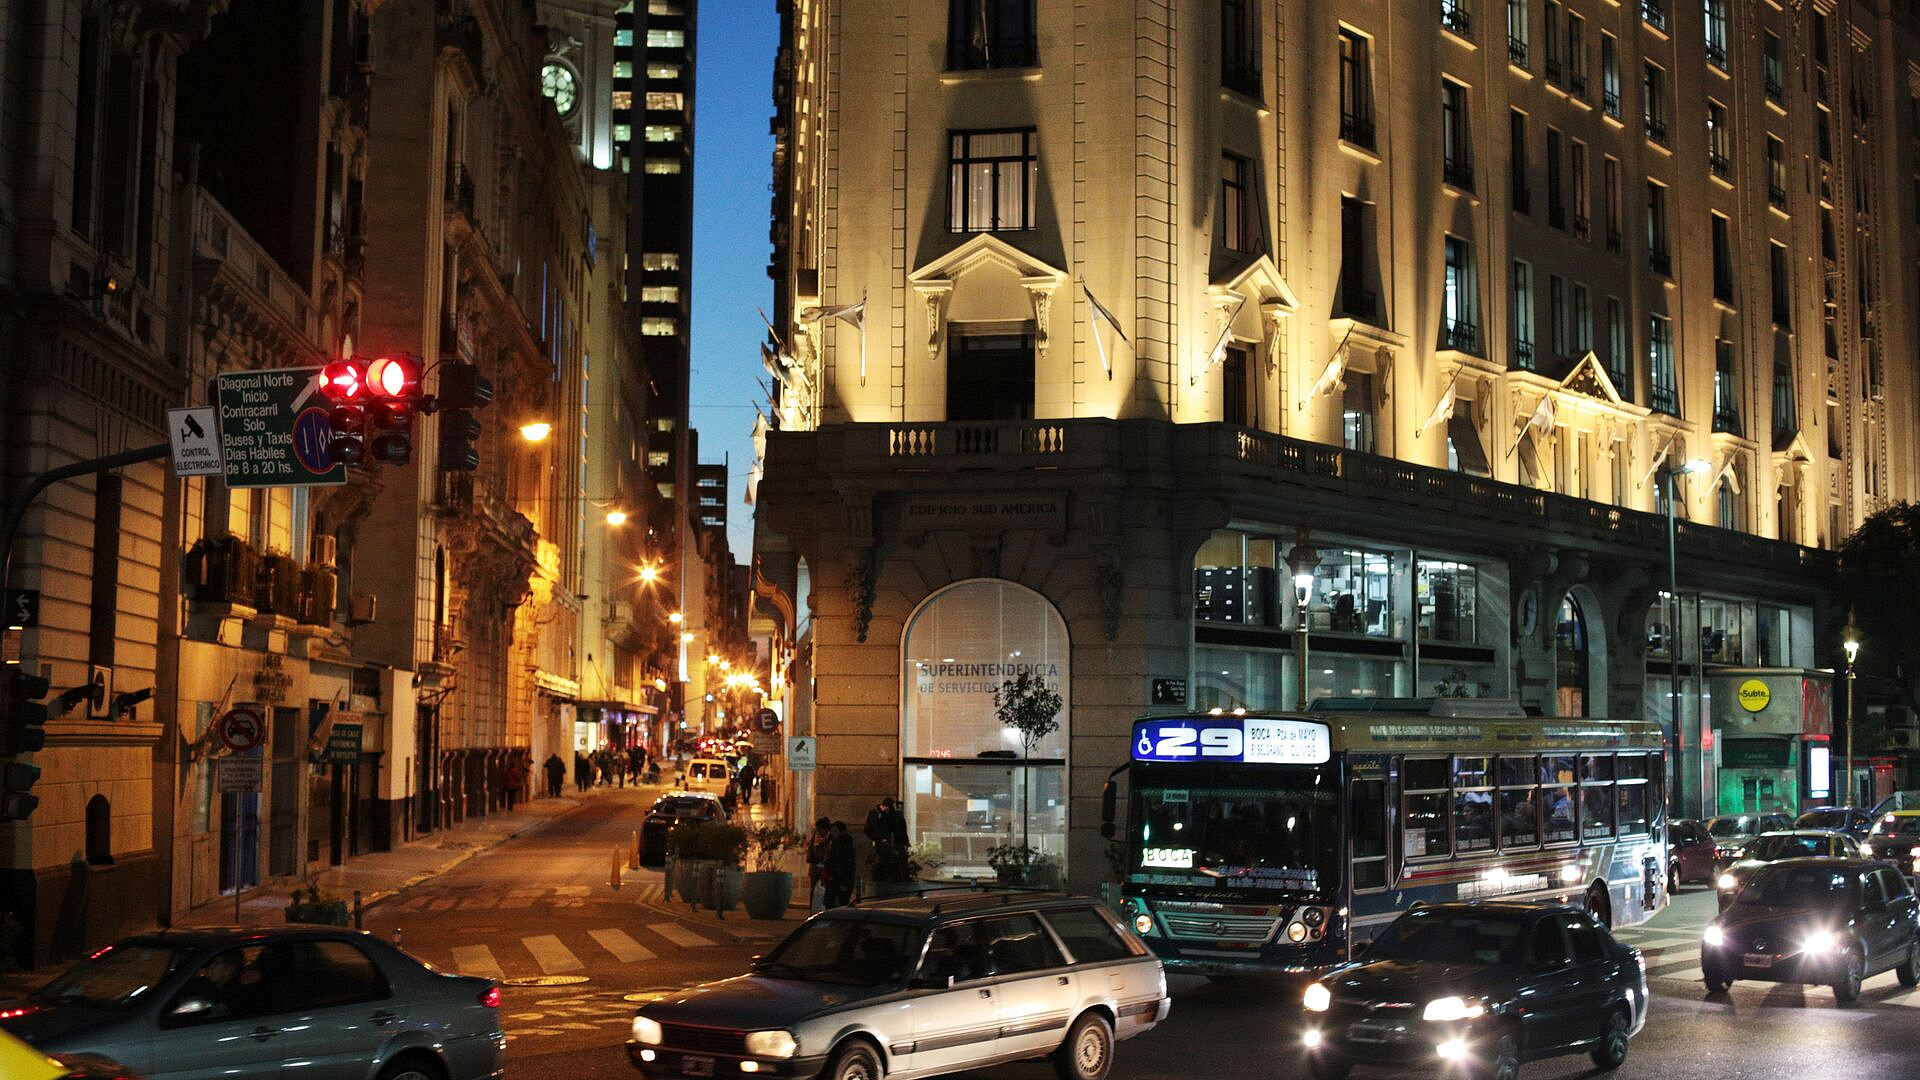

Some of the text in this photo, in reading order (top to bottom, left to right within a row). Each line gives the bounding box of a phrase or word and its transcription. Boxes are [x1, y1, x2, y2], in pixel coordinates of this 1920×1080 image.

[220, 373, 293, 392] Diagonal Norte
[242, 391, 269, 403] Inicio
[221, 403, 278, 418] Contracarril
[243, 418, 266, 432] Solo
[224, 431, 292, 447] Buses y Taxis
[181, 447, 211, 457] CONTROL
[227, 461, 293, 475] de 8 a 20 hs.
[910, 503, 1057, 515] EDIFICIO SUD AMERICA
[920, 663, 1058, 677] SUPERINTENDENCIA
[920, 682, 934, 693] DE
[938, 682, 1000, 693] SERVICIOS
[1742, 689, 1766, 698] Subte
[761, 713, 774, 729] E
[1251, 727, 1270, 740] BOCA
[1155, 727, 1243, 756] 29
[1147, 850, 1191, 862] BOCA
